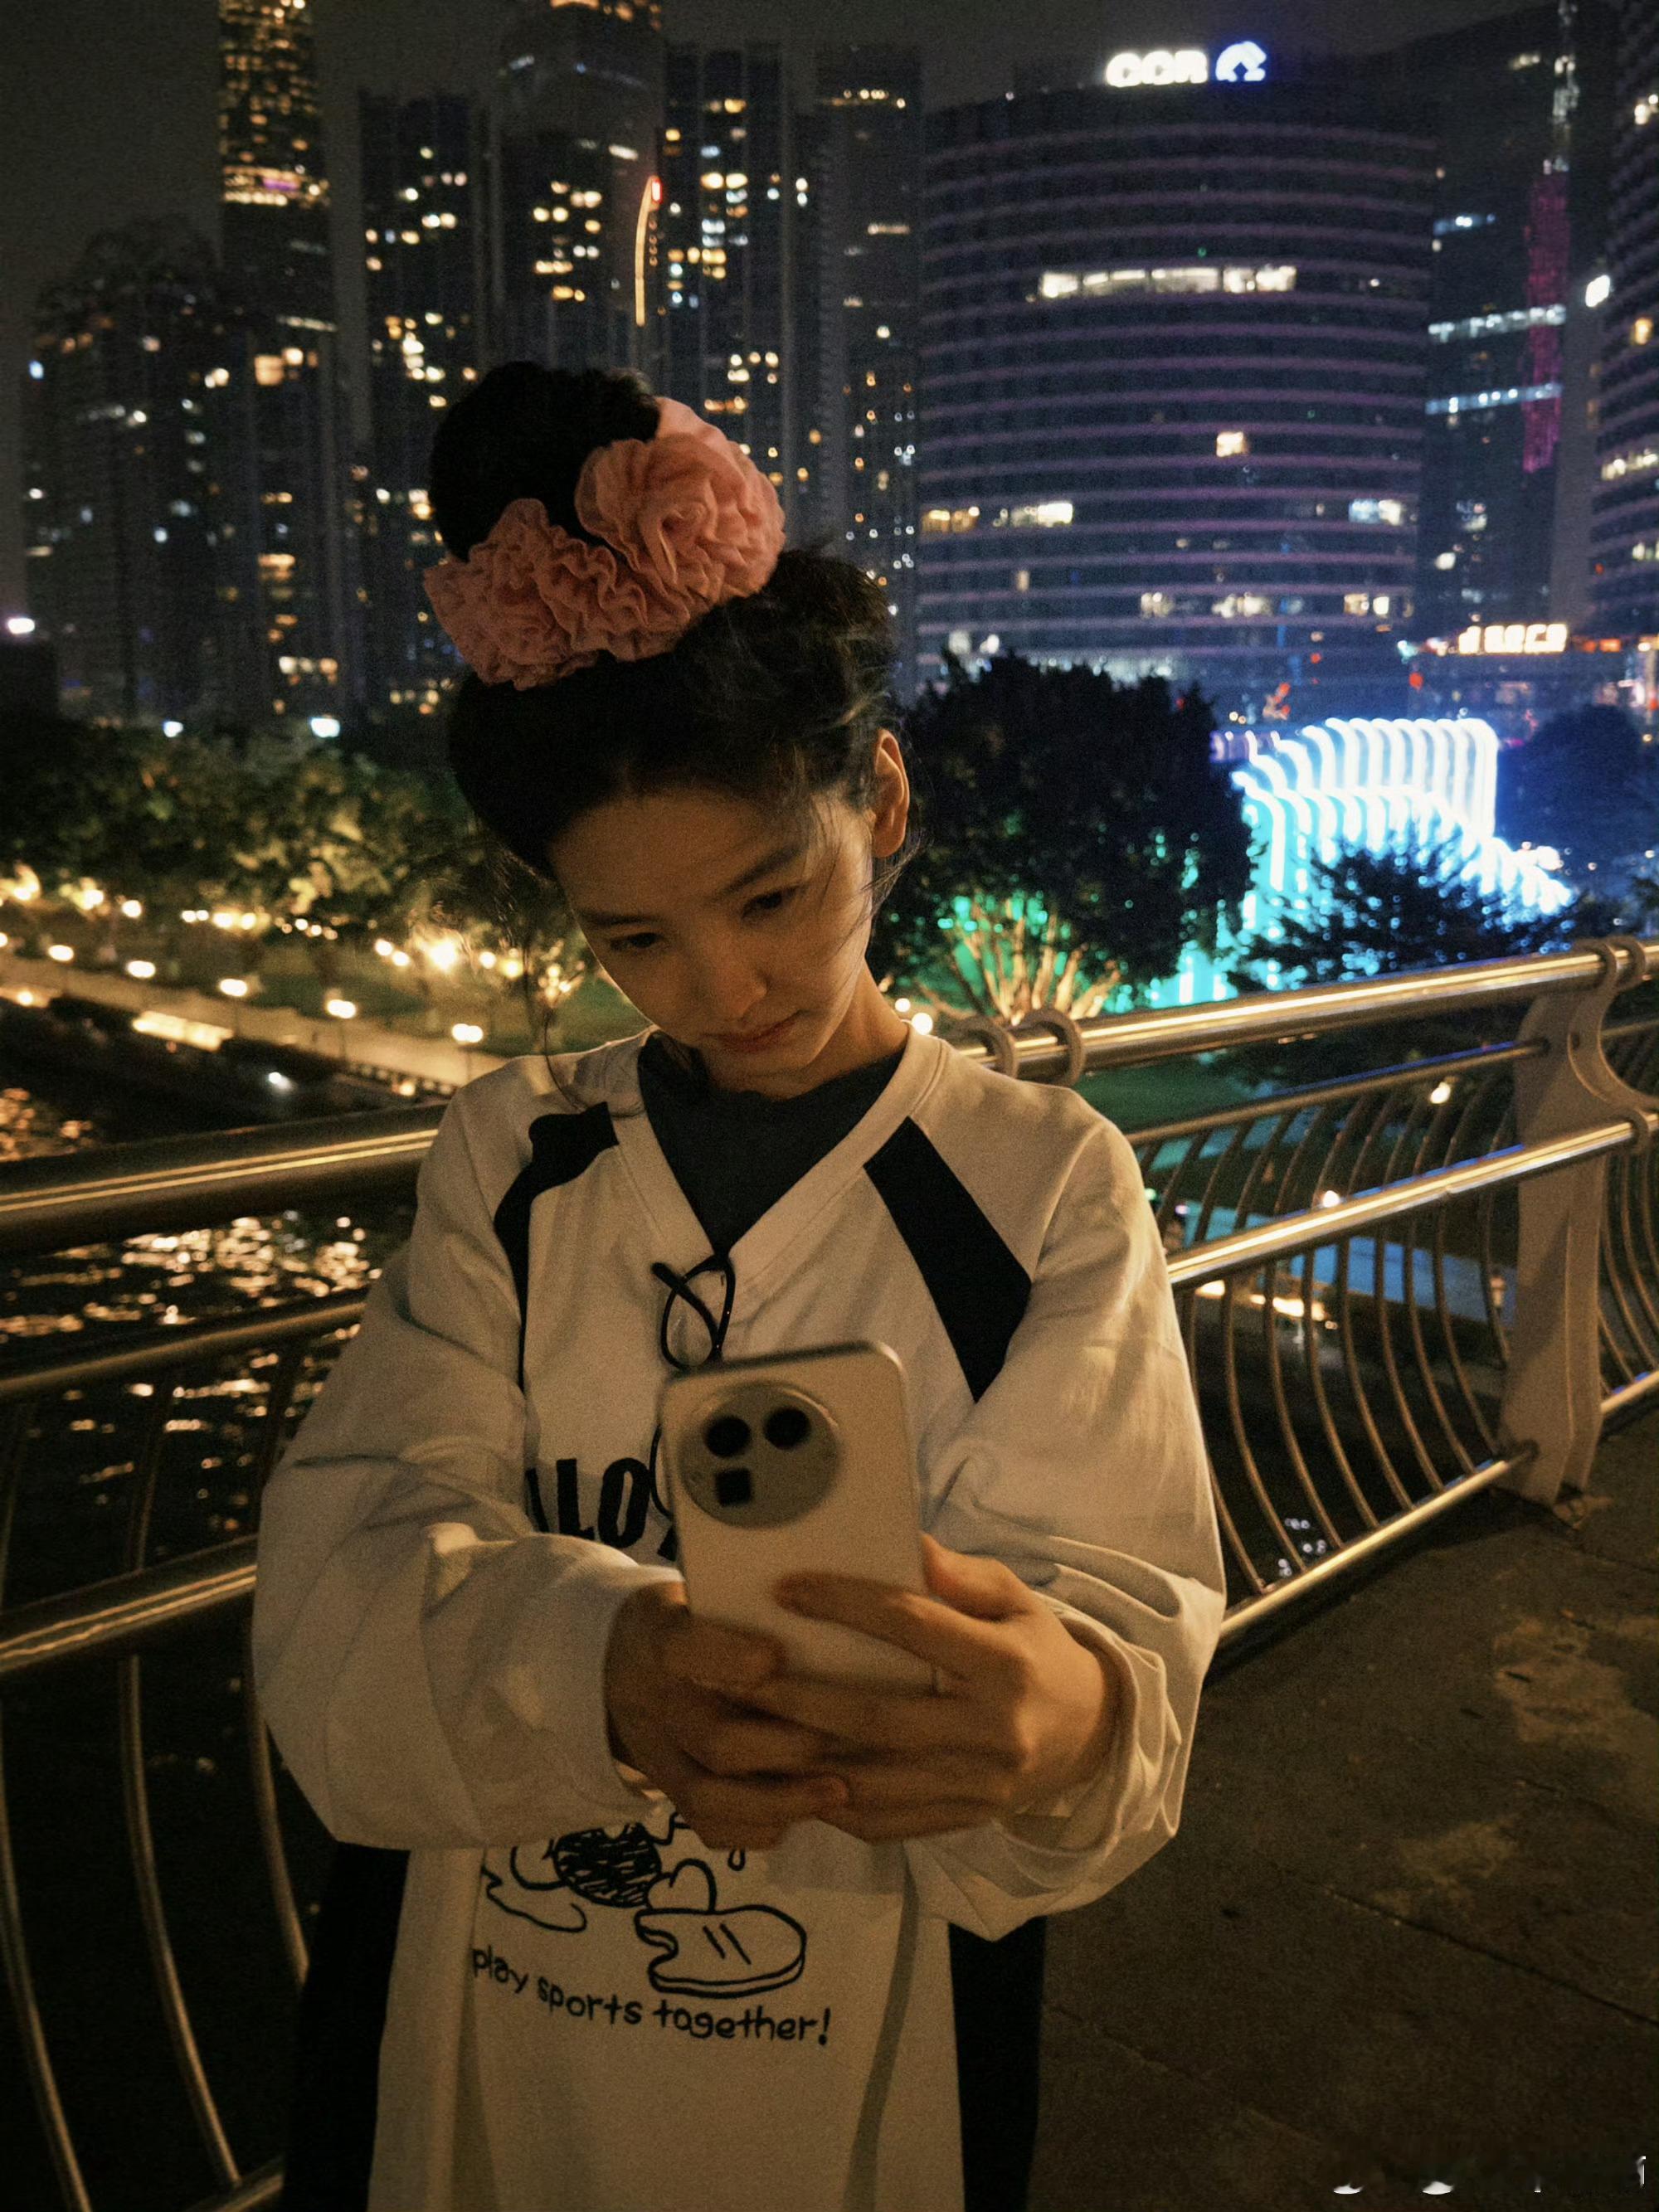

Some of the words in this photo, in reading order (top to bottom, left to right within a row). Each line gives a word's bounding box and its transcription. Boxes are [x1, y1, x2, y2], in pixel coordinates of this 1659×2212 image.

[472, 1945, 528, 1994] play
[537, 1976, 642, 2029] sports
[651, 1998, 830, 2046] together!
